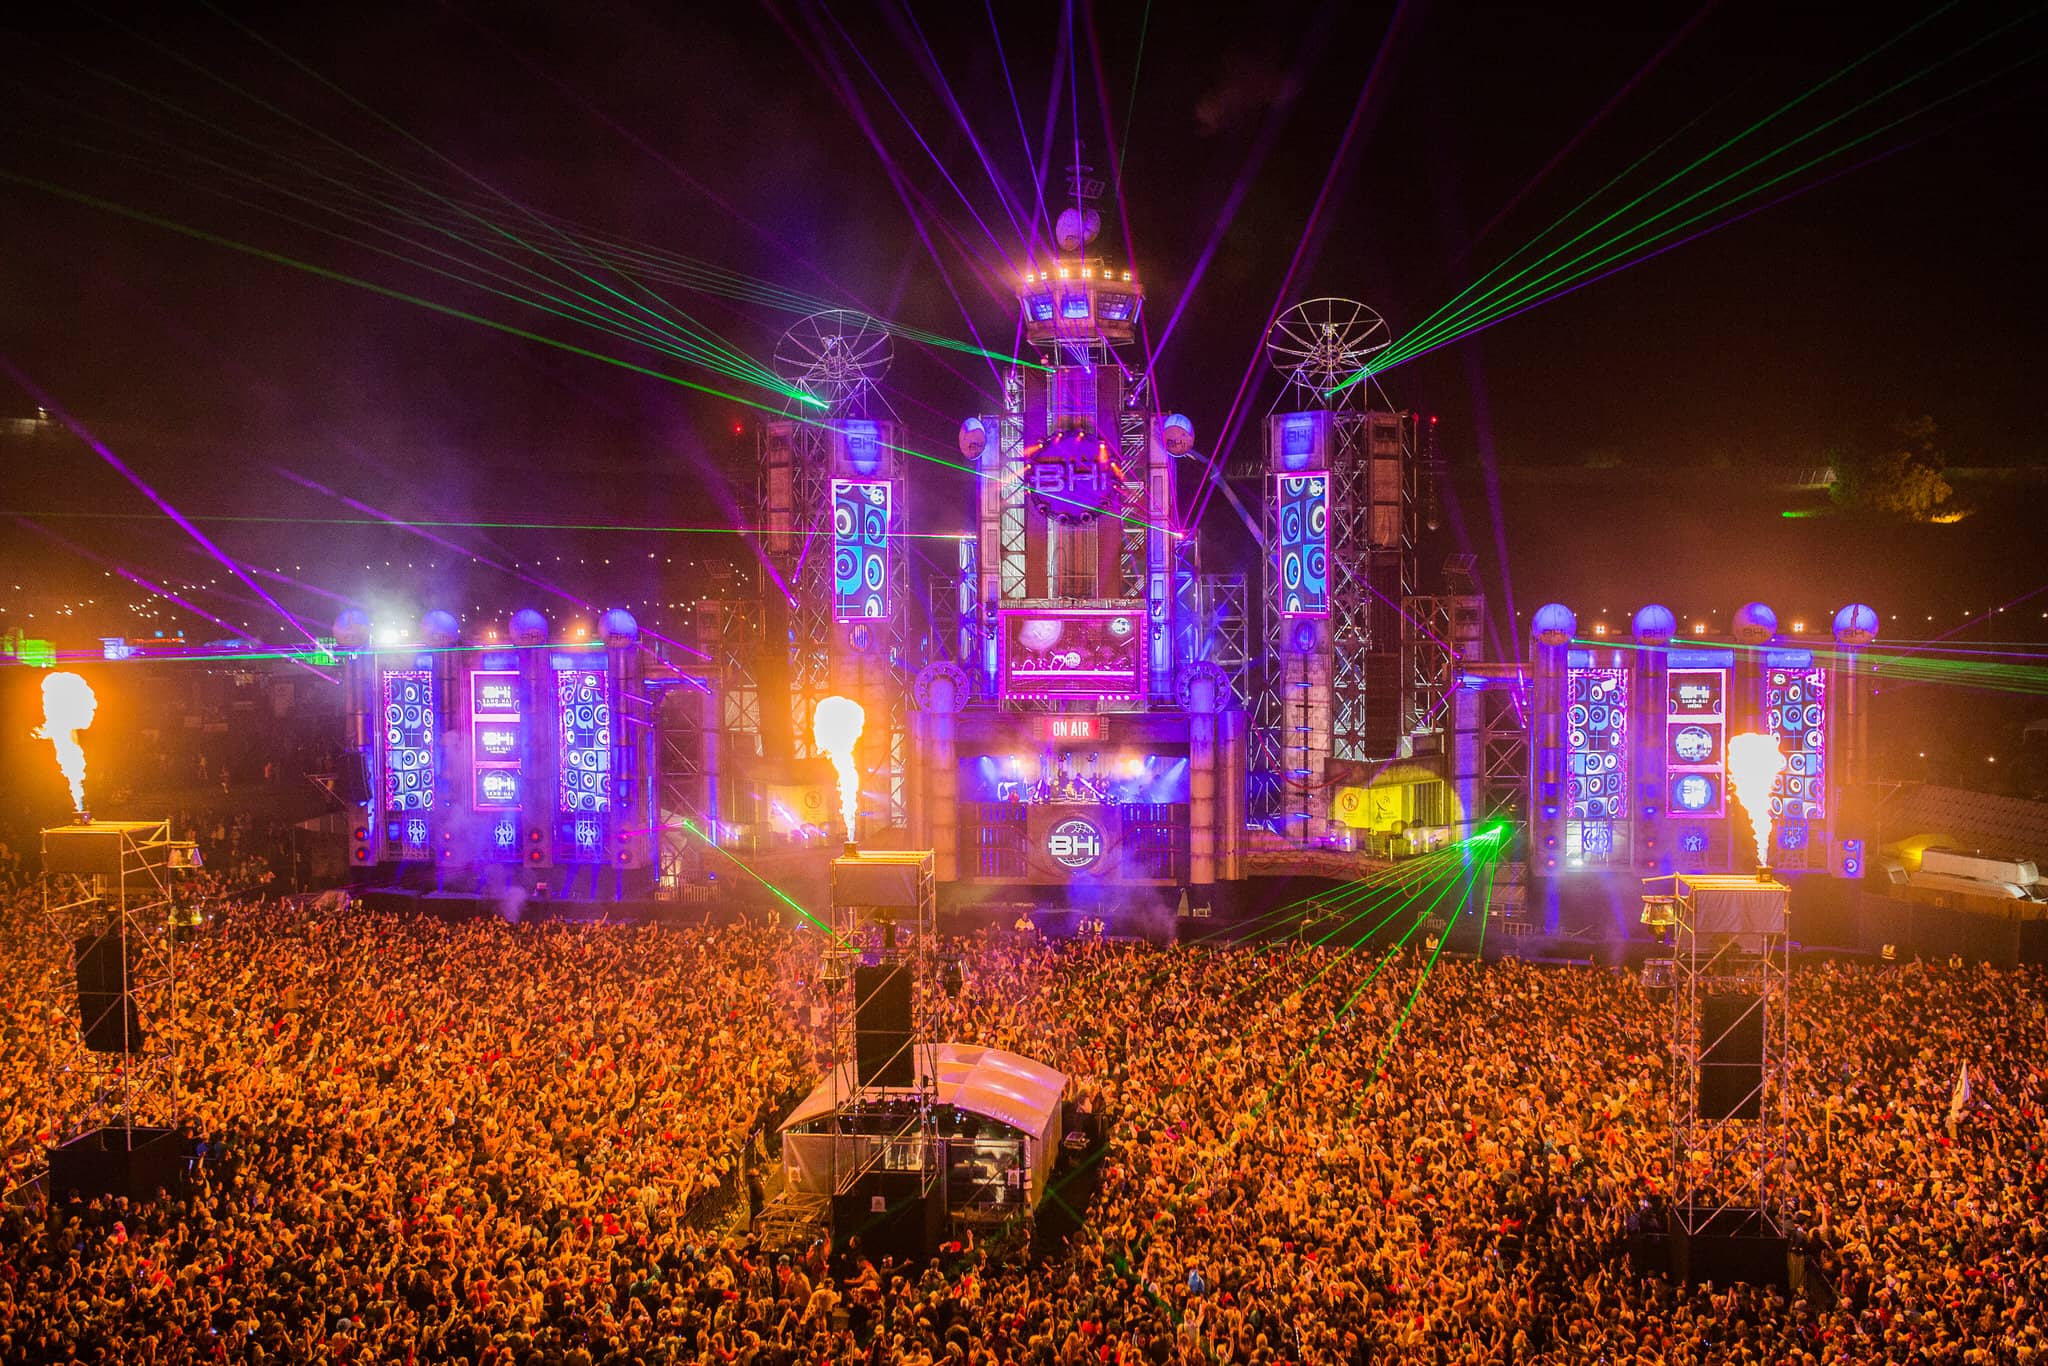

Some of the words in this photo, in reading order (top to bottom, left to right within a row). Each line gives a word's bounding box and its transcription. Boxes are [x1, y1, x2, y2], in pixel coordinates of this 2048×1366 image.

[1031, 461, 1107, 492] BHi
[1053, 721, 1068, 737] ON
[1071, 721, 1089, 737] AIR
[1048, 834, 1100, 856] BHi
